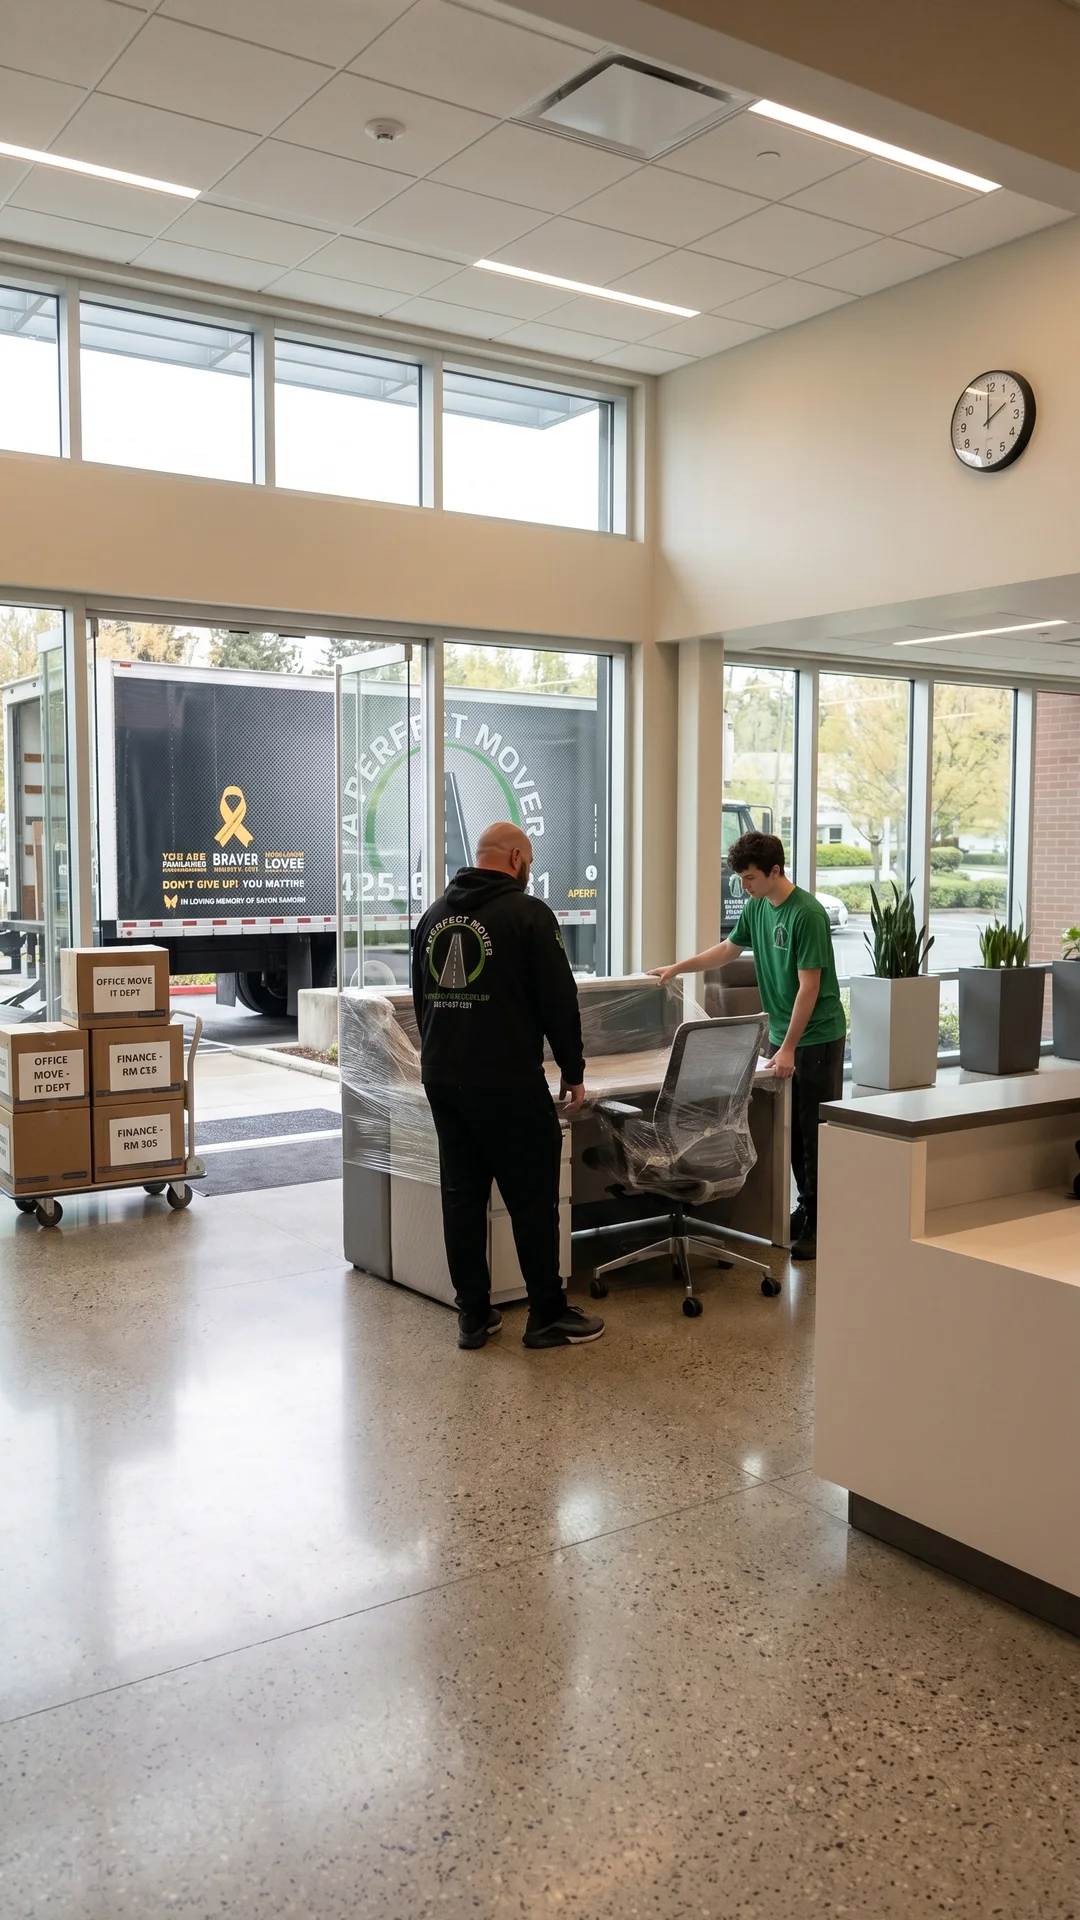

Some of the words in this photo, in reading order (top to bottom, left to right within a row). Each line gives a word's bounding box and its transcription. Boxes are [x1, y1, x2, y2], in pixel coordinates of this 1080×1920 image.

[986, 382, 995, 393] 12
[1002, 384, 1006, 393] 1
[1010, 393, 1016, 403] 2
[965, 405, 974, 416] 10
[1013, 409, 1019, 419] 3
[961, 423, 967, 433] 9
[1009, 427, 1015, 436] 4
[964, 439, 970, 449] 8
[1000, 442, 1006, 452] 5
[974, 448, 980, 456] 7
[986, 449, 992, 459] 6
[343, 712, 468, 803] PERFET
[474, 723, 545, 838] MOVER
[342, 813, 359, 838] A
[213, 853, 259, 866] BRAVER
[265, 858, 304, 869] LOVEE
[162, 880, 194, 890] DON'T
[197, 880, 219, 889] GIVE
[242, 880, 262, 888] YOU
[470, 919, 493, 956] MOVER
[96, 977, 126, 986] OFFICE
[127, 977, 153, 986] MOVE
[110, 989, 118, 997] IT
[120, 988, 141, 997] DEPT
[34, 1056, 68, 1066] OFFICE
[117, 1053, 156, 1063] FINANCE
[34, 1070, 64, 1080] MOVE
[122, 1067, 138, 1077] RM
[34, 1085, 44, 1094] IT
[46, 1082, 71, 1093] DEPT
[117, 1126, 158, 1138] FINANCE
[123, 1141, 140, 1150] RM
[141, 1139, 158, 1149] 305
